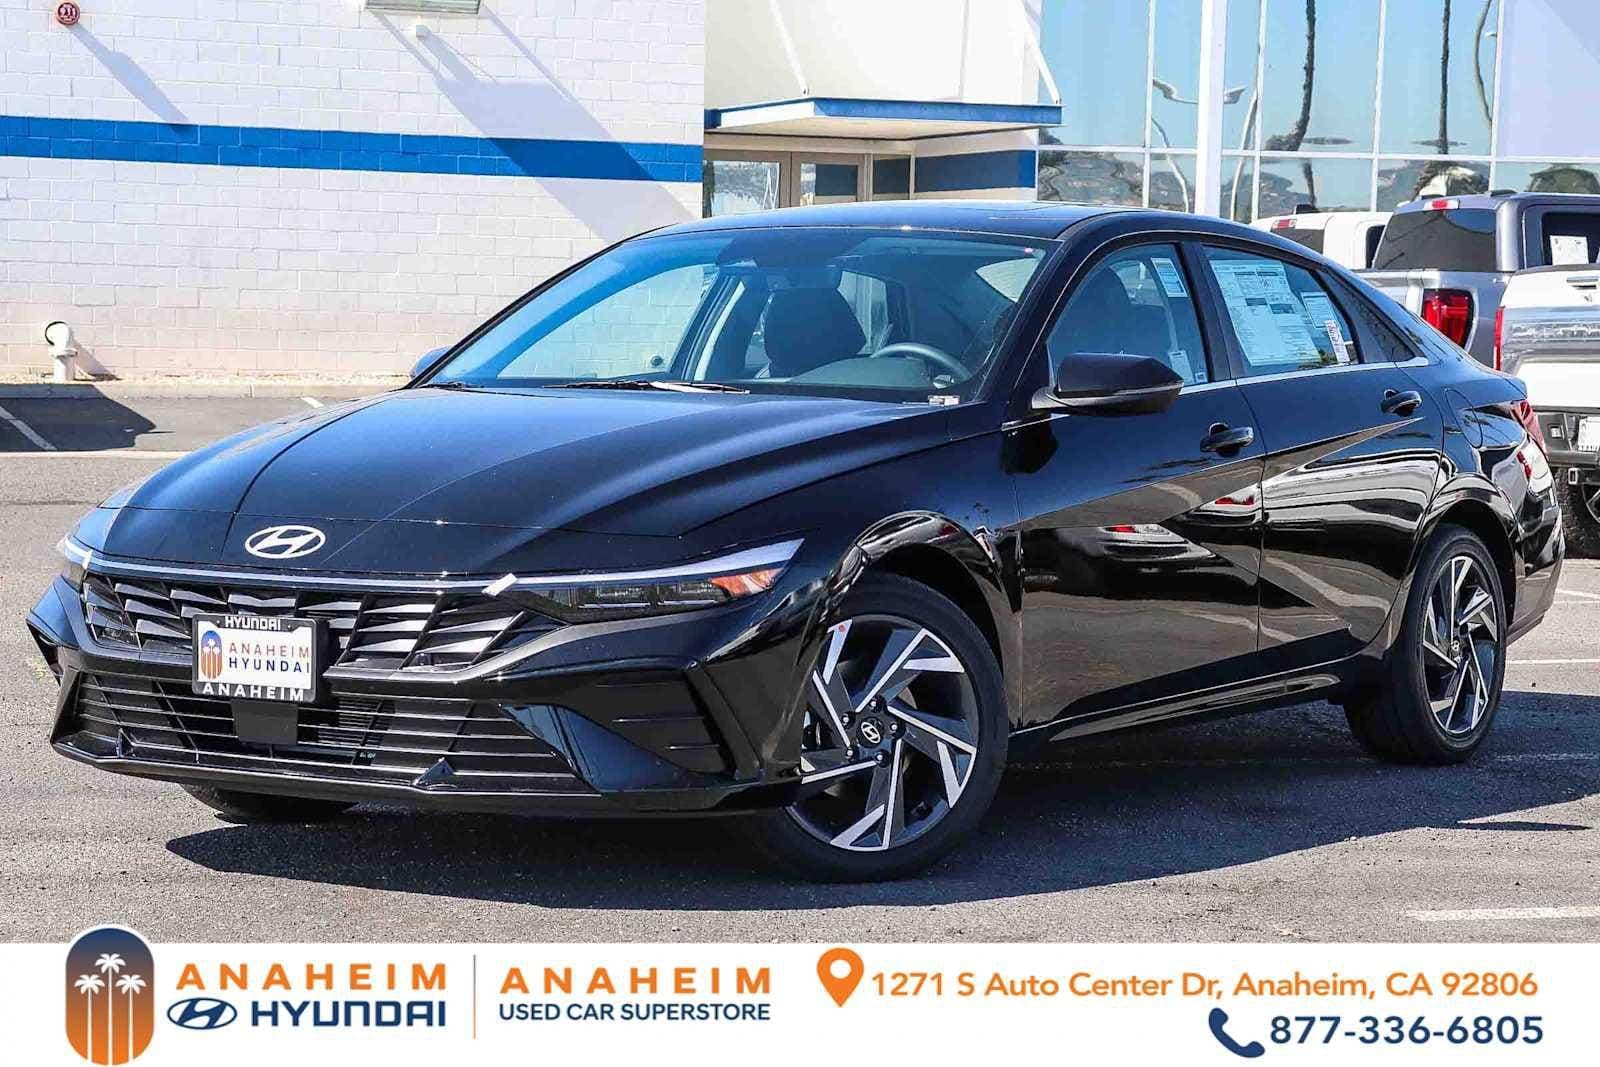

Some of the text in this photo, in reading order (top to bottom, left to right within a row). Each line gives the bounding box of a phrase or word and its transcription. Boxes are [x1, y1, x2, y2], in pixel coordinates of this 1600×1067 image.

[224, 615, 281, 631] HYUNDAI
[229, 642, 310, 658] ANAHEIM
[229, 657, 310, 673] HYUNDAI
[202, 682, 304, 702] ANAHEIM
